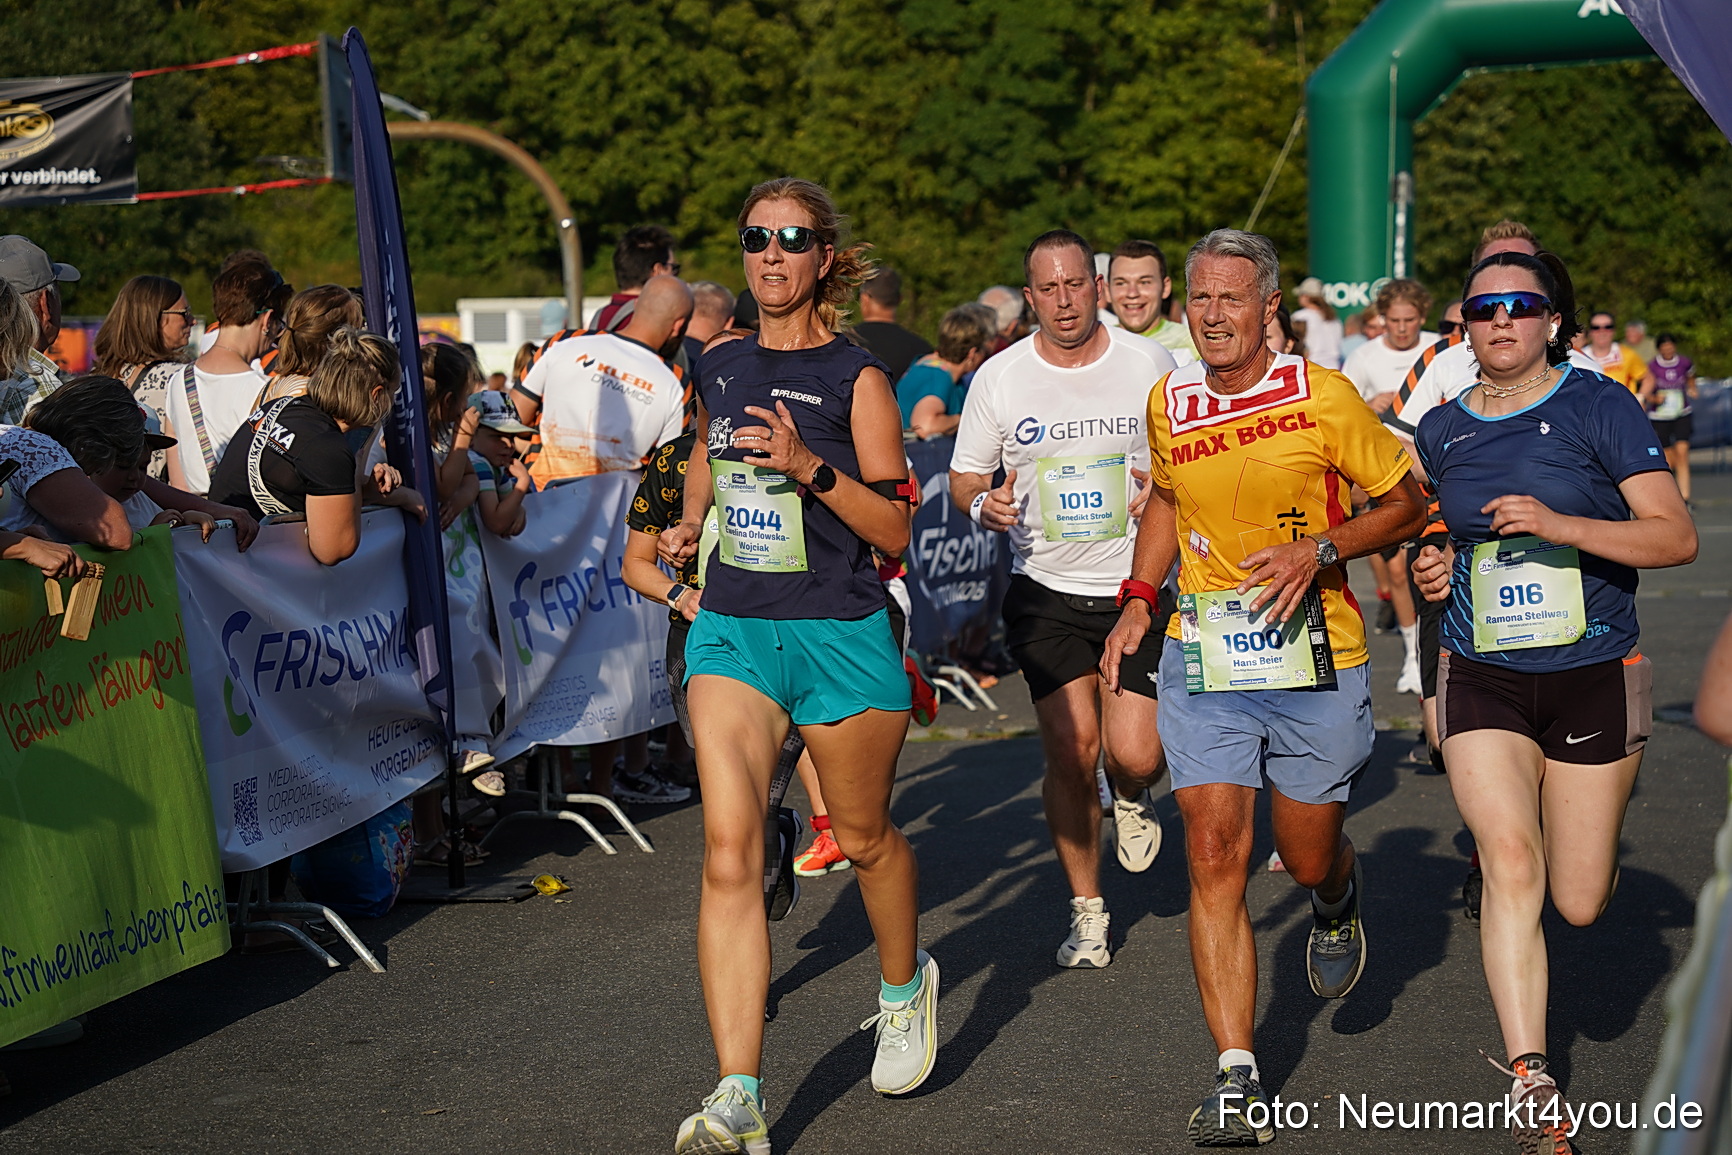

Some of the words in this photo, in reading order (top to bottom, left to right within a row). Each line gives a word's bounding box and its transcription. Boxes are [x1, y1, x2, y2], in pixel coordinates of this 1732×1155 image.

[11, 166, 101, 185] verbindet.
[591, 373, 655, 405] DYNAMICS
[597, 362, 656, 394] KLEBL
[779, 389, 822, 406] PFLEIDERER
[1050, 417, 1139, 440] GEITNER
[1170, 432, 1230, 467] MAX
[1235, 411, 1317, 446] BÖGL
[1059, 491, 1103, 509] 1013
[725, 505, 782, 531] 2044
[1056, 512, 1088, 521] Benedikt
[1090, 511, 1113, 519] Strobl
[725, 525, 748, 538] Ewelina
[748, 530, 790, 541] Orlowska-
[738, 541, 769, 552] Wojciak
[1493, 559, 1524, 570] Firmenlauf
[1499, 583, 1544, 607] 916
[1486, 615, 1523, 624] Ramona
[1525, 610, 1569, 621] Stellwag
[1222, 628, 1283, 655] 1600
[1580, 624, 1611, 641] 026
[1233, 659, 1257, 668] Hans
[1259, 656, 1283, 666] Beier
[1316, 646, 1327, 677] HILTL
[0, 670, 95, 752] laufen
[528, 714, 579, 736] CORPORATE
[575, 706, 617, 728] SIGNAGE
[368, 719, 405, 752] HEUTE
[268, 765, 299, 789] MEDIA
[370, 746, 416, 787] MORGEN
[267, 779, 322, 812] CORPORATE
[269, 808, 320, 835] CORPORATE
[321, 788, 352, 816] SIGNAGE
